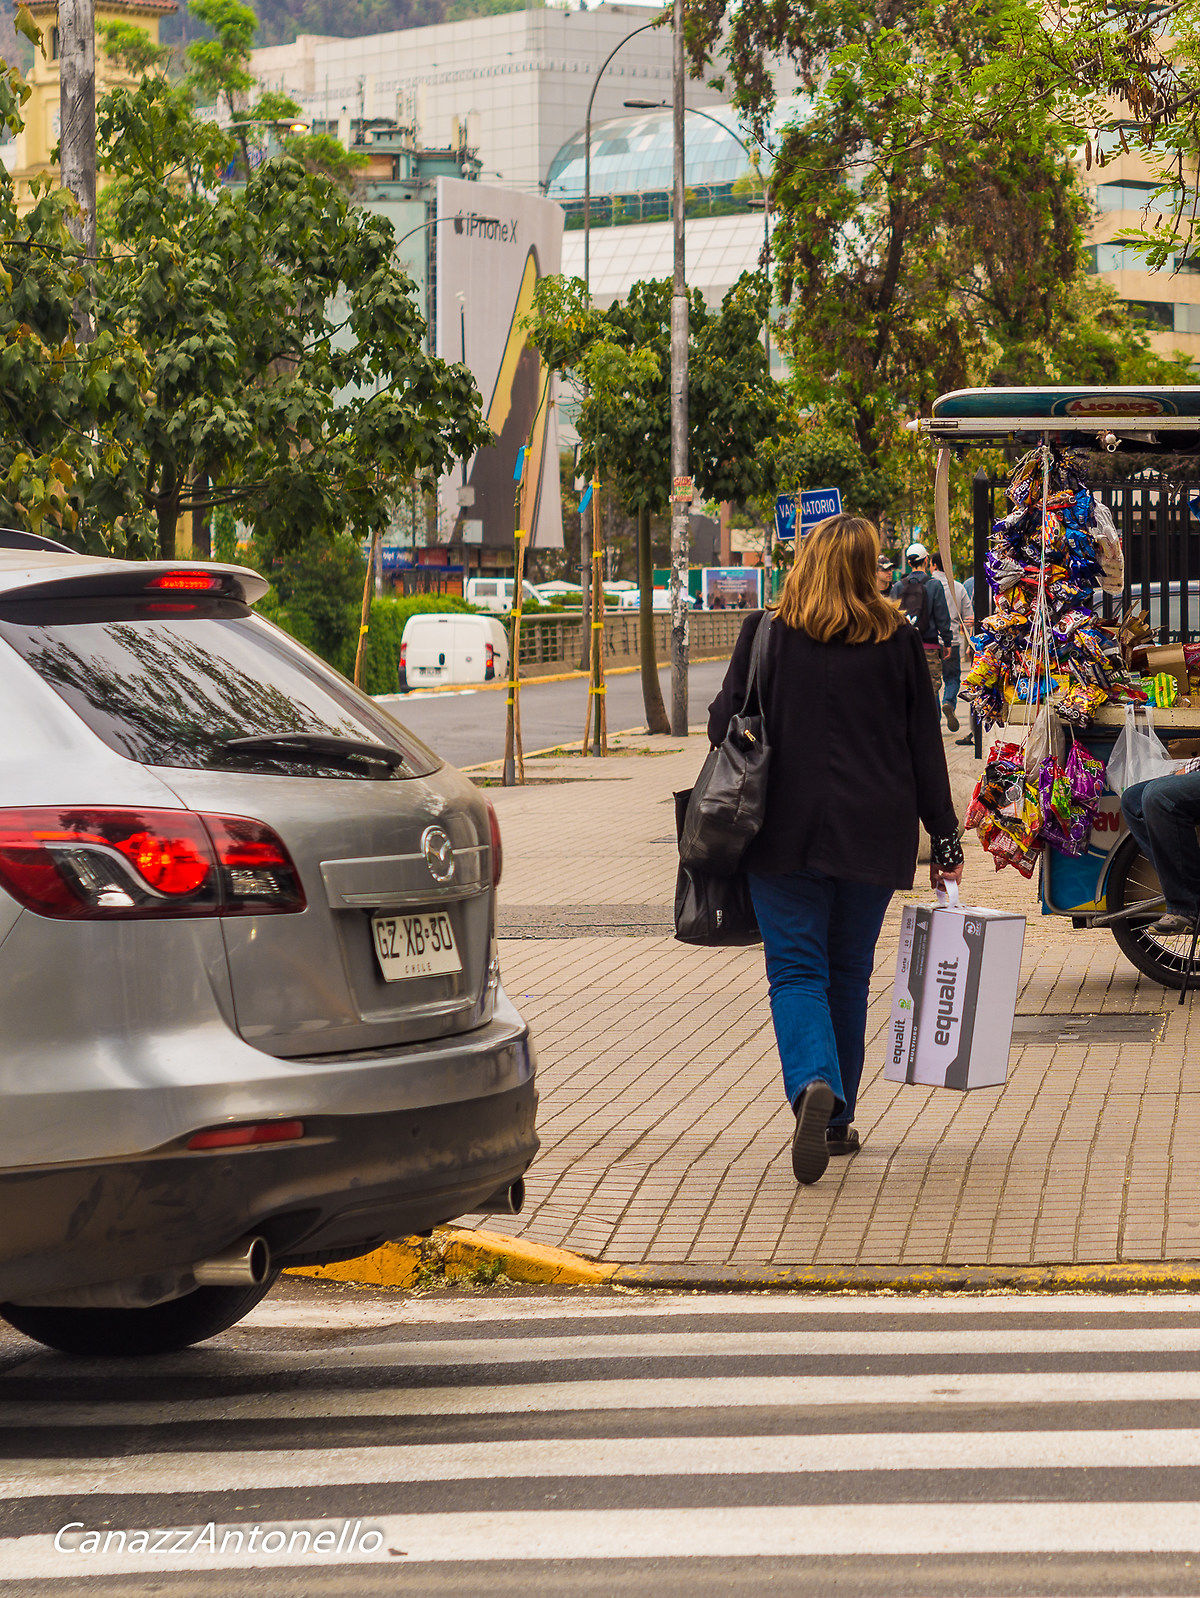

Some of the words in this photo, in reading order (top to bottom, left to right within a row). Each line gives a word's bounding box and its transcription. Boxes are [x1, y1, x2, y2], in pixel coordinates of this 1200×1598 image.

[466, 212, 508, 242] iPhone
[509, 219, 518, 243] X
[779, 498, 836, 518] VACNATORIO
[404, 961, 432, 974] CHILE
[934, 959, 959, 1046] equalit
[892, 1018, 906, 1065] equalit
[909, 1026, 918, 1063] MULTIUSO
